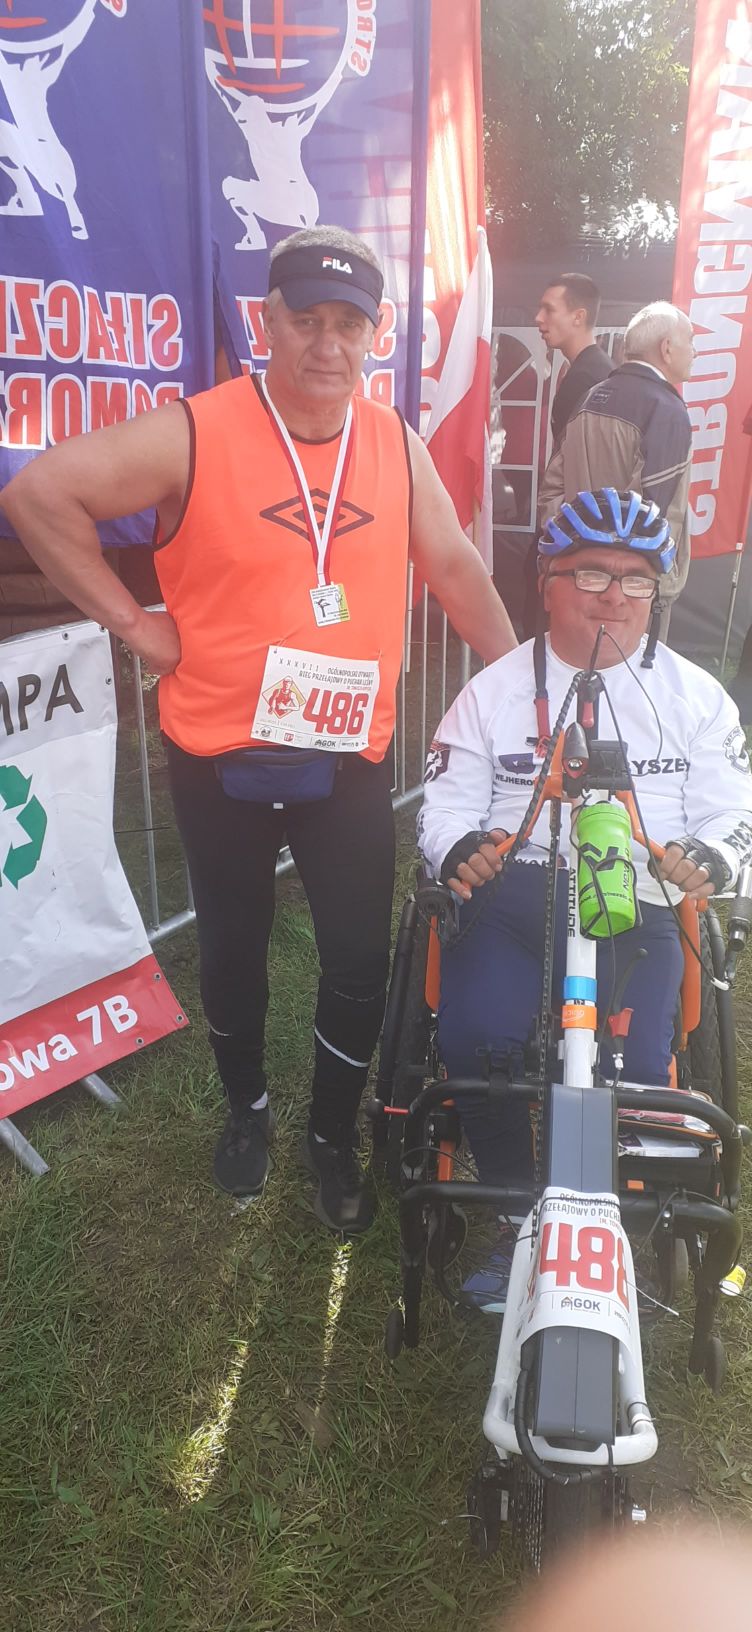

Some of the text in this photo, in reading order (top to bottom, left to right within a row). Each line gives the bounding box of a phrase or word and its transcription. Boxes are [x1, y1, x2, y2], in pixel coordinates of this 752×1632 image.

[322, 255, 353, 274] FILA
[302, 687, 369, 736] 486
[568, 867, 577, 938] ATTITUDE
[76, 994, 138, 1046] 7B
[590, 1208, 596, 1217] O
[573, 1297, 601, 1312] GOK
